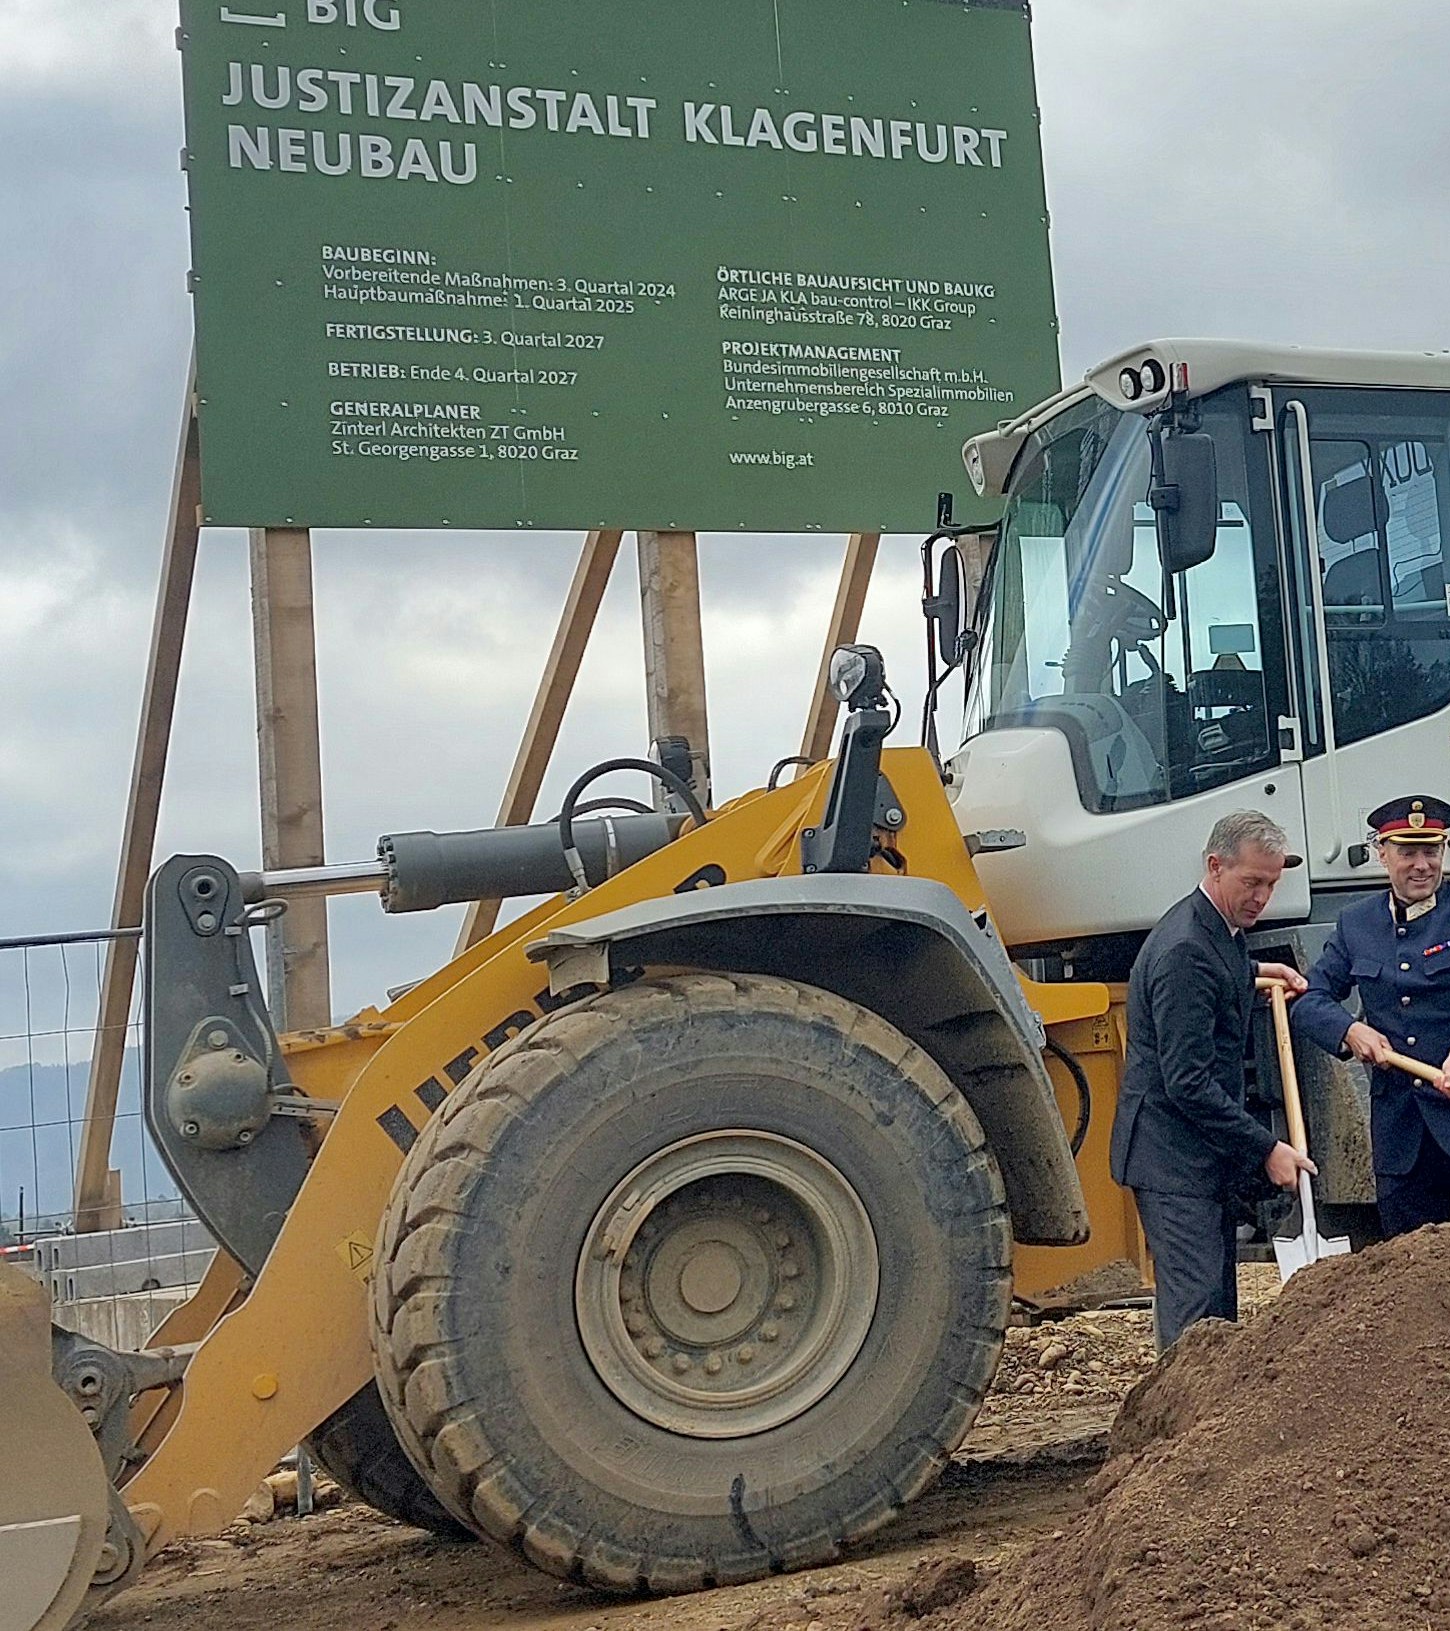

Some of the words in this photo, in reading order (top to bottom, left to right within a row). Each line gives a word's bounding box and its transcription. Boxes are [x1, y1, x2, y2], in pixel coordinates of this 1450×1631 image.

[307, 0, 400, 31] BIG
[221, 61, 657, 140] JUSTIZANSTALT
[684, 102, 1008, 169] KLAGENFURT
[228, 124, 477, 185] NEUBAU
[322, 245, 437, 266] BAUBEGINN:
[322, 264, 441, 286] Vorbereitende
[444, 271, 553, 292] Maßnahmen:
[556, 279, 572, 292] 3.
[575, 279, 634, 297] Quartal
[637, 283, 676, 298] 2024
[717, 266, 792, 287] ÖRTLICHE
[797, 273, 901, 294] BAUAUFSICHT
[905, 279, 941, 295] UND
[944, 281, 996, 298] BAUKG
[323, 284, 508, 308] Hauptbaumaßnahme:
[514, 293, 530, 309] 1.
[532, 295, 593, 313] Quartal
[596, 299, 635, 315] 2025
[718, 287, 758, 303] ARGE
[761, 289, 778, 304] JA
[780, 290, 807, 305] KLA
[811, 293, 892, 310] bau-control
[908, 298, 932, 312] IKK
[934, 300, 976, 318] Group
[719, 304, 853, 326] Reininghausstraße
[856, 311, 878, 328] 78,
[882, 315, 916, 328] 8020
[920, 316, 952, 330] Graz
[326, 322, 479, 345] FERTIGSTELLUNG:
[482, 330, 498, 345] 3.
[501, 331, 561, 349] Quartal
[565, 334, 605, 350] 2027
[722, 341, 901, 362] PROJEKTMANAGEMENT
[328, 362, 406, 379] BETRIEB:
[410, 366, 451, 382] Ende
[454, 367, 469, 382] 4.
[473, 368, 535, 386] Quartal
[538, 371, 578, 386] 2027
[723, 359, 941, 383] Bundesimmobiliengesellschaft
[944, 369, 988, 384] m.b.H.
[724, 377, 884, 398] Unternehmensbereich
[888, 385, 1015, 402] Spezialimmobilien
[330, 401, 482, 420] GENERALPLANER
[726, 396, 859, 417] Anzengrubergasse
[862, 402, 877, 417] 6,
[878, 402, 914, 416] 8010
[916, 403, 949, 417] Graz
[331, 420, 386, 436] Zinterl
[391, 421, 486, 440] Architekten
[490, 425, 510, 440] ZT
[514, 425, 566, 441] GmbH
[332, 440, 355, 456] St.
[358, 441, 476, 462] Georgengasse
[479, 445, 495, 461] 1,
[498, 445, 539, 460] 8020
[541, 446, 579, 461] Graz
[729, 450, 814, 469] www.big.at
